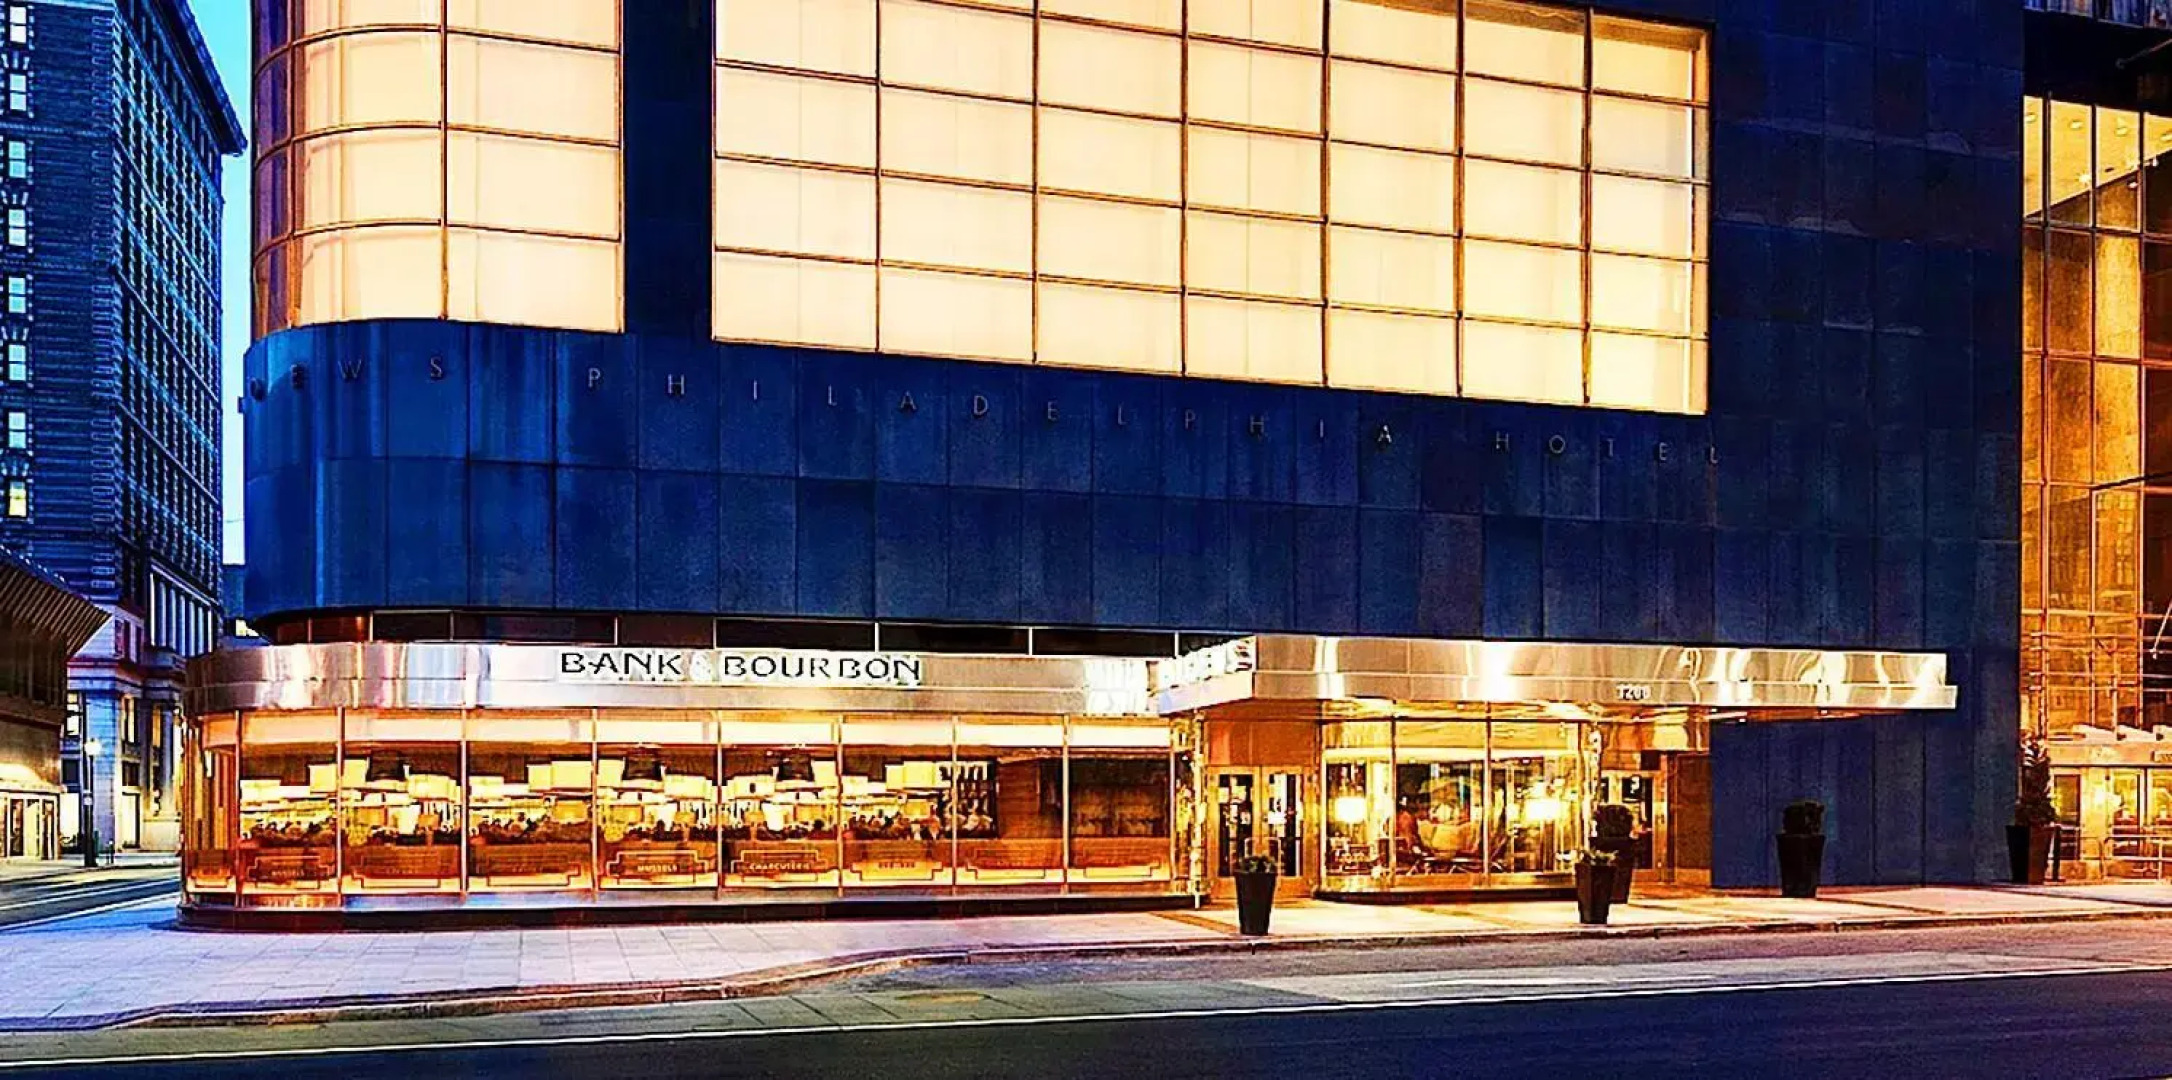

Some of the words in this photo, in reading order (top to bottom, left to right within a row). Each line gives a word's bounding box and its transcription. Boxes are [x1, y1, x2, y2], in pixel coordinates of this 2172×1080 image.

[587, 367, 1392, 444] PHILADELPHIA
[1495, 431, 1719, 464] HOTEL
[561, 652, 682, 675] BANK
[724, 656, 920, 680] BOURBON
